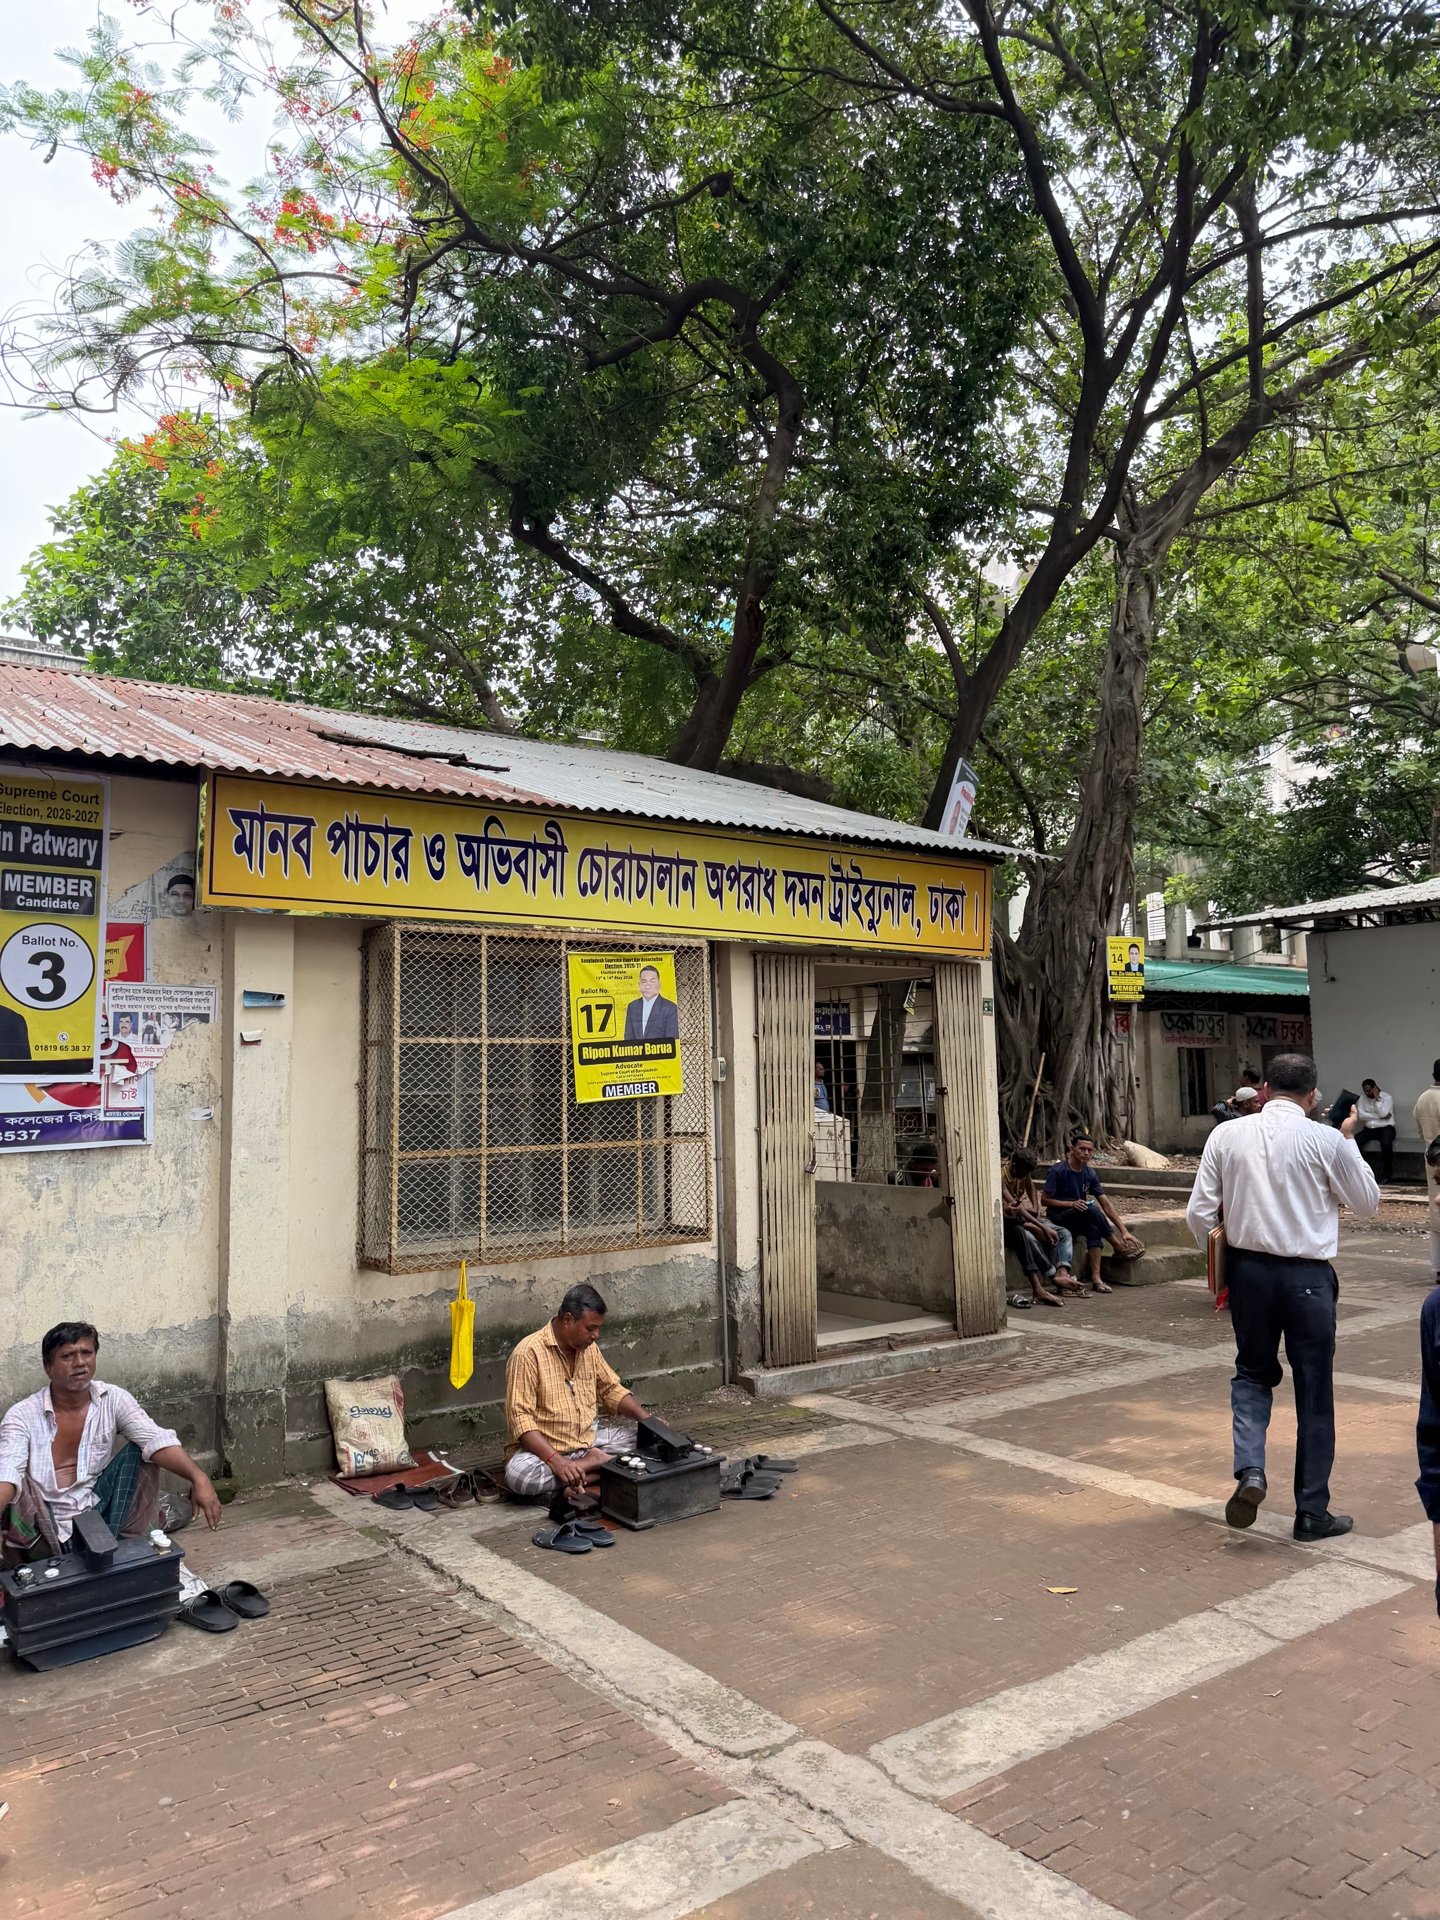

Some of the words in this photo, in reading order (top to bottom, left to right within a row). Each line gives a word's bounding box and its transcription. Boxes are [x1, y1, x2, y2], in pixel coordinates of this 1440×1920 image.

[62, 790, 100, 805] Court
[47, 807, 99, 822] 2026-2027
[20, 826, 98, 866] Patwary
[227, 800, 318, 879] মানব
[327, 811, 413, 887] পাচার
[423, 833, 446, 882] ও
[454, 815, 569, 899] অভিবাসী
[578, 840, 699, 911] চোরাচালান
[704, 857, 777, 917] অপরাধ
[782, 869, 826, 922] দমন
[927, 880, 966, 935] ঢাকা
[4, 874, 93, 897] MEMBER
[16, 895, 80, 910] Candidate
[22, 935, 56, 946] Ballot
[60, 937, 78, 948] No.
[1112, 954, 1123, 963] 14
[26, 951, 67, 1002] 3
[580, 1004, 613, 1033] 17
[582, 1046, 610, 1060] Ripon
[612, 1045, 643, 1057] Kumar
[645, 1043, 672, 1054] Barua
[120, 1087, 137, 1100] চাই
[606, 1082, 656, 1097] MEMBER
[4, 1114, 64, 1126] কলেজের
